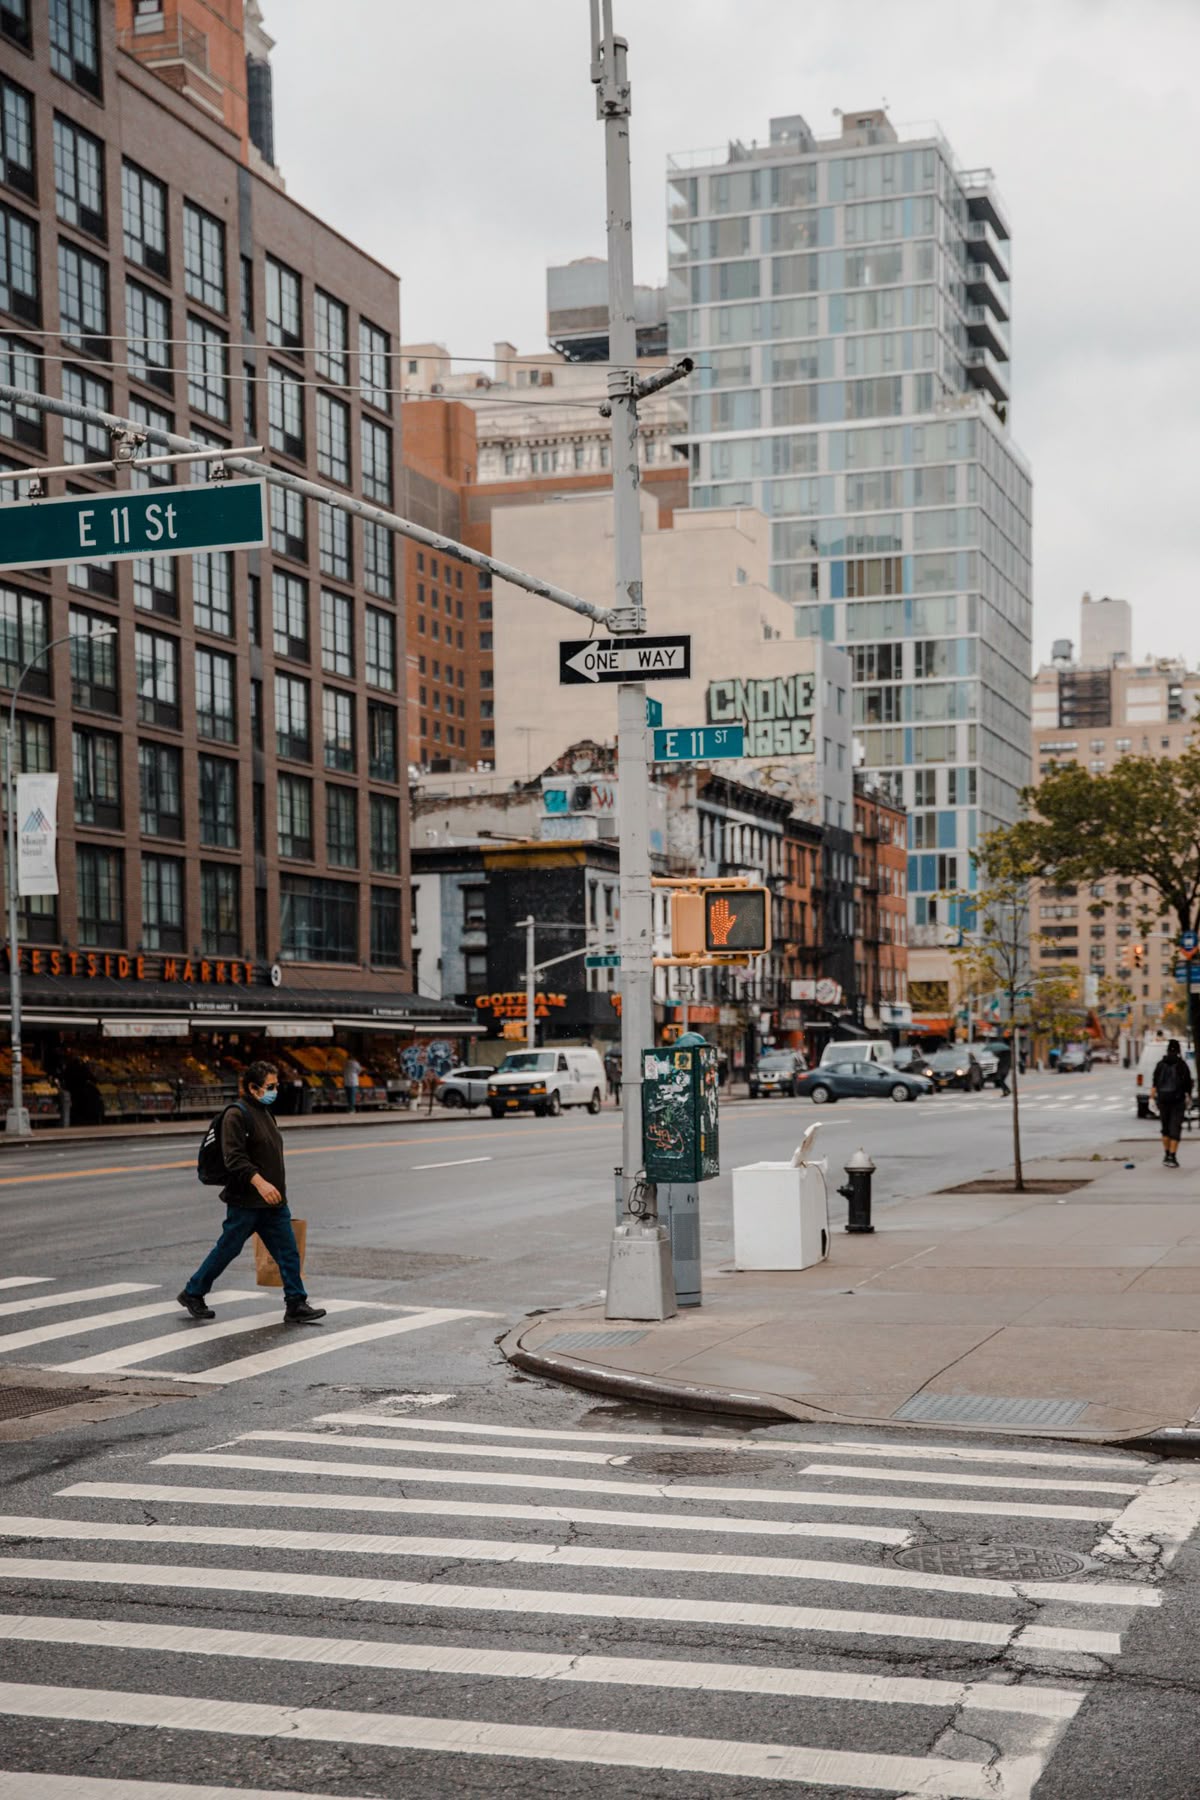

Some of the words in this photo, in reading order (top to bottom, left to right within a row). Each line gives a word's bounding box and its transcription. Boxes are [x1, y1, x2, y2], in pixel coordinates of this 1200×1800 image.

[79, 510, 97, 547] E
[110, 507, 130, 544] 11
[145, 503, 178, 541] St
[584, 652, 619, 670] ONE
[638, 649, 677, 667] WAY
[666, 732, 679, 757] E
[690, 731, 704, 756] 11
[714, 730, 729, 744] ST
[164, 959, 253, 985] MARKET
[493, 1006, 552, 1018] PIZA
